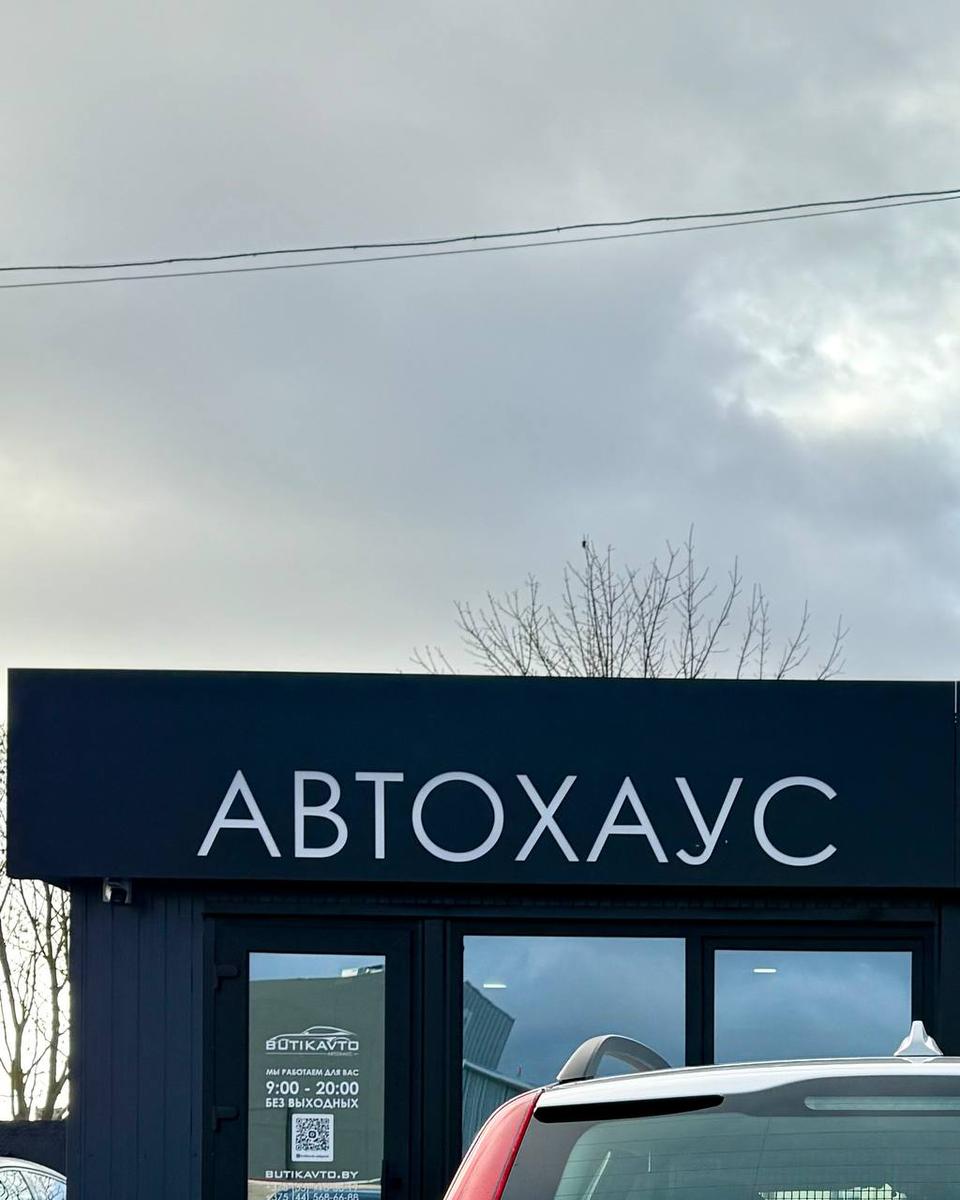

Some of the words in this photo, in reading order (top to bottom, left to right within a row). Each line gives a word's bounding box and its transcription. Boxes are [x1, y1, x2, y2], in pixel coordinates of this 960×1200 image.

[197, 769, 838, 868] АВТОХАУС
[265, 1039, 360, 1051] BUTIKAVTO
[324, 1069, 341, 1077] ДЛЯ
[266, 1081, 299, 1095] 9:00
[316, 1081, 359, 1095] 20:00
[265, 1098, 284, 1108] БЕЗ
[288, 1098, 359, 1109] ВЫХОДНЫХ
[265, 1170, 359, 1179] BUTIKAVTO.BY
